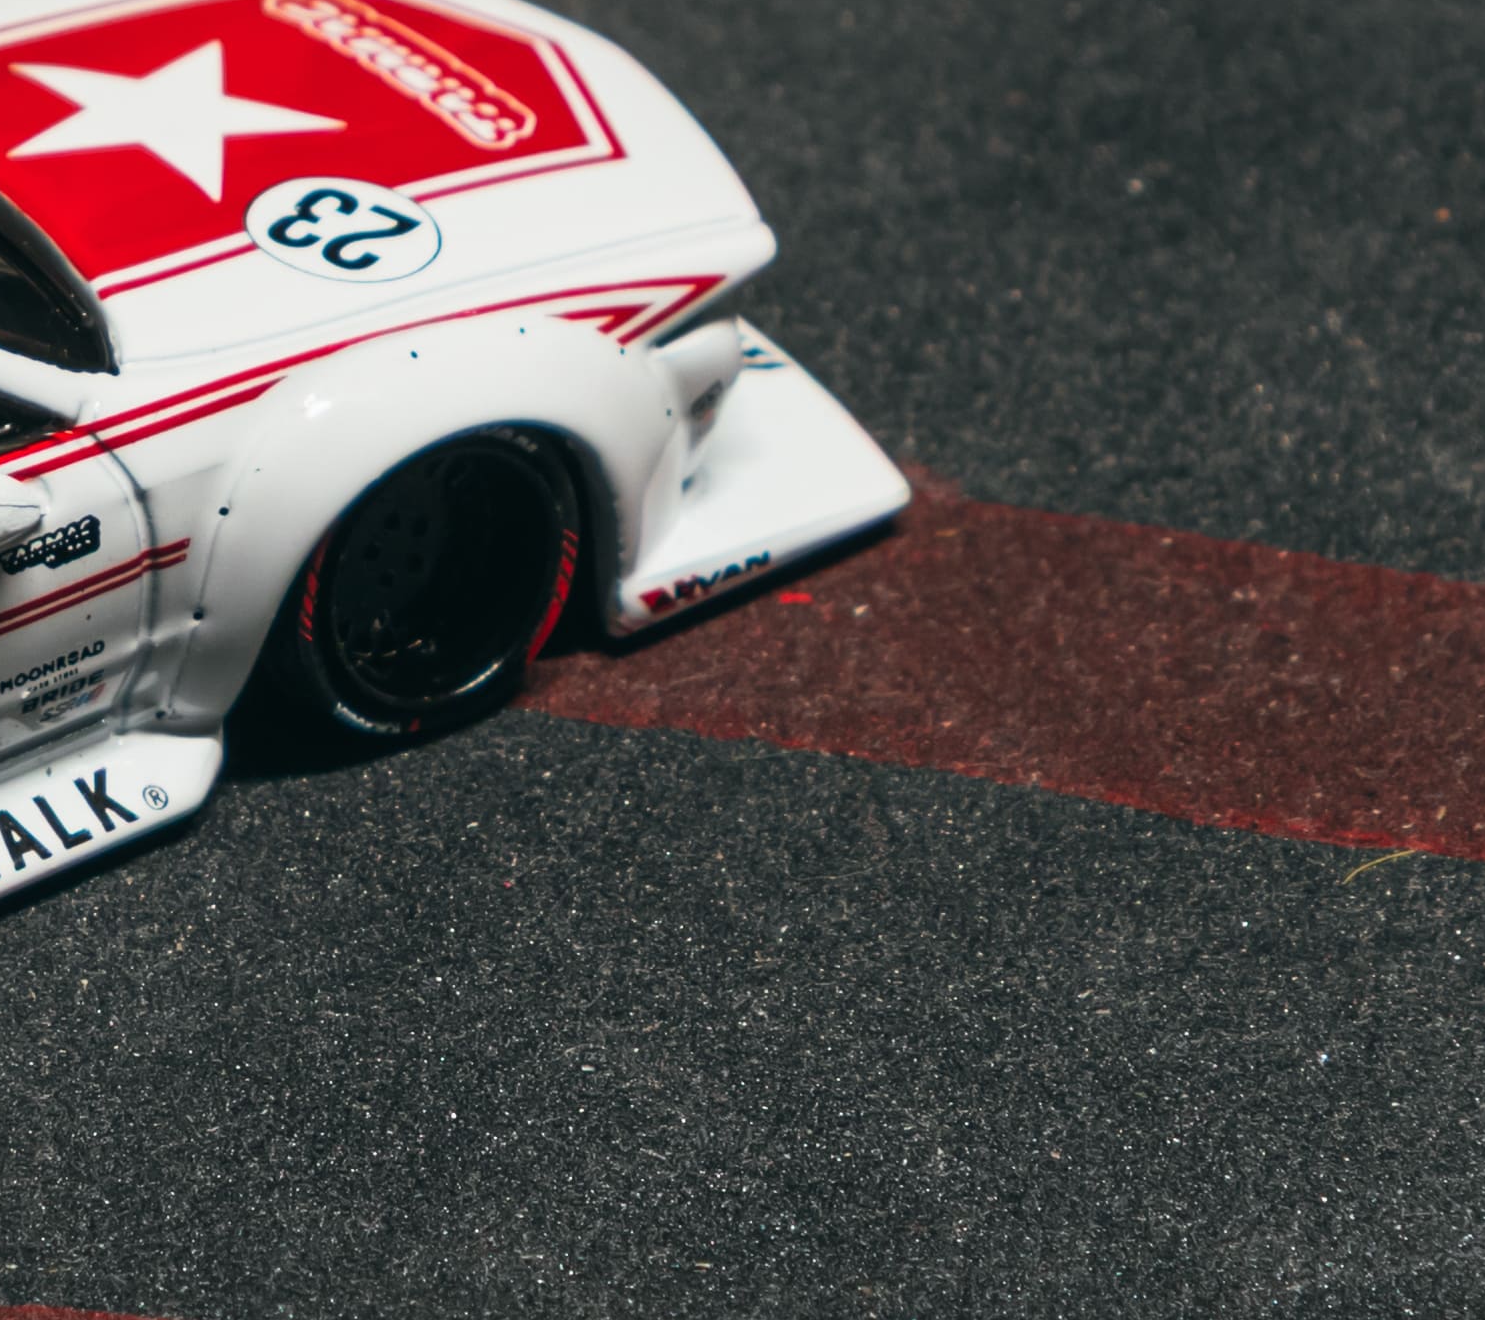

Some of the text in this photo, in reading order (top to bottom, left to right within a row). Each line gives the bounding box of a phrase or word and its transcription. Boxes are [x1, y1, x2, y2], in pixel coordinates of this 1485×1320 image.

[268, 189, 421, 270] 23
[0, 516, 96, 571] TARMAC
[22, 670, 104, 714] BRIDE
